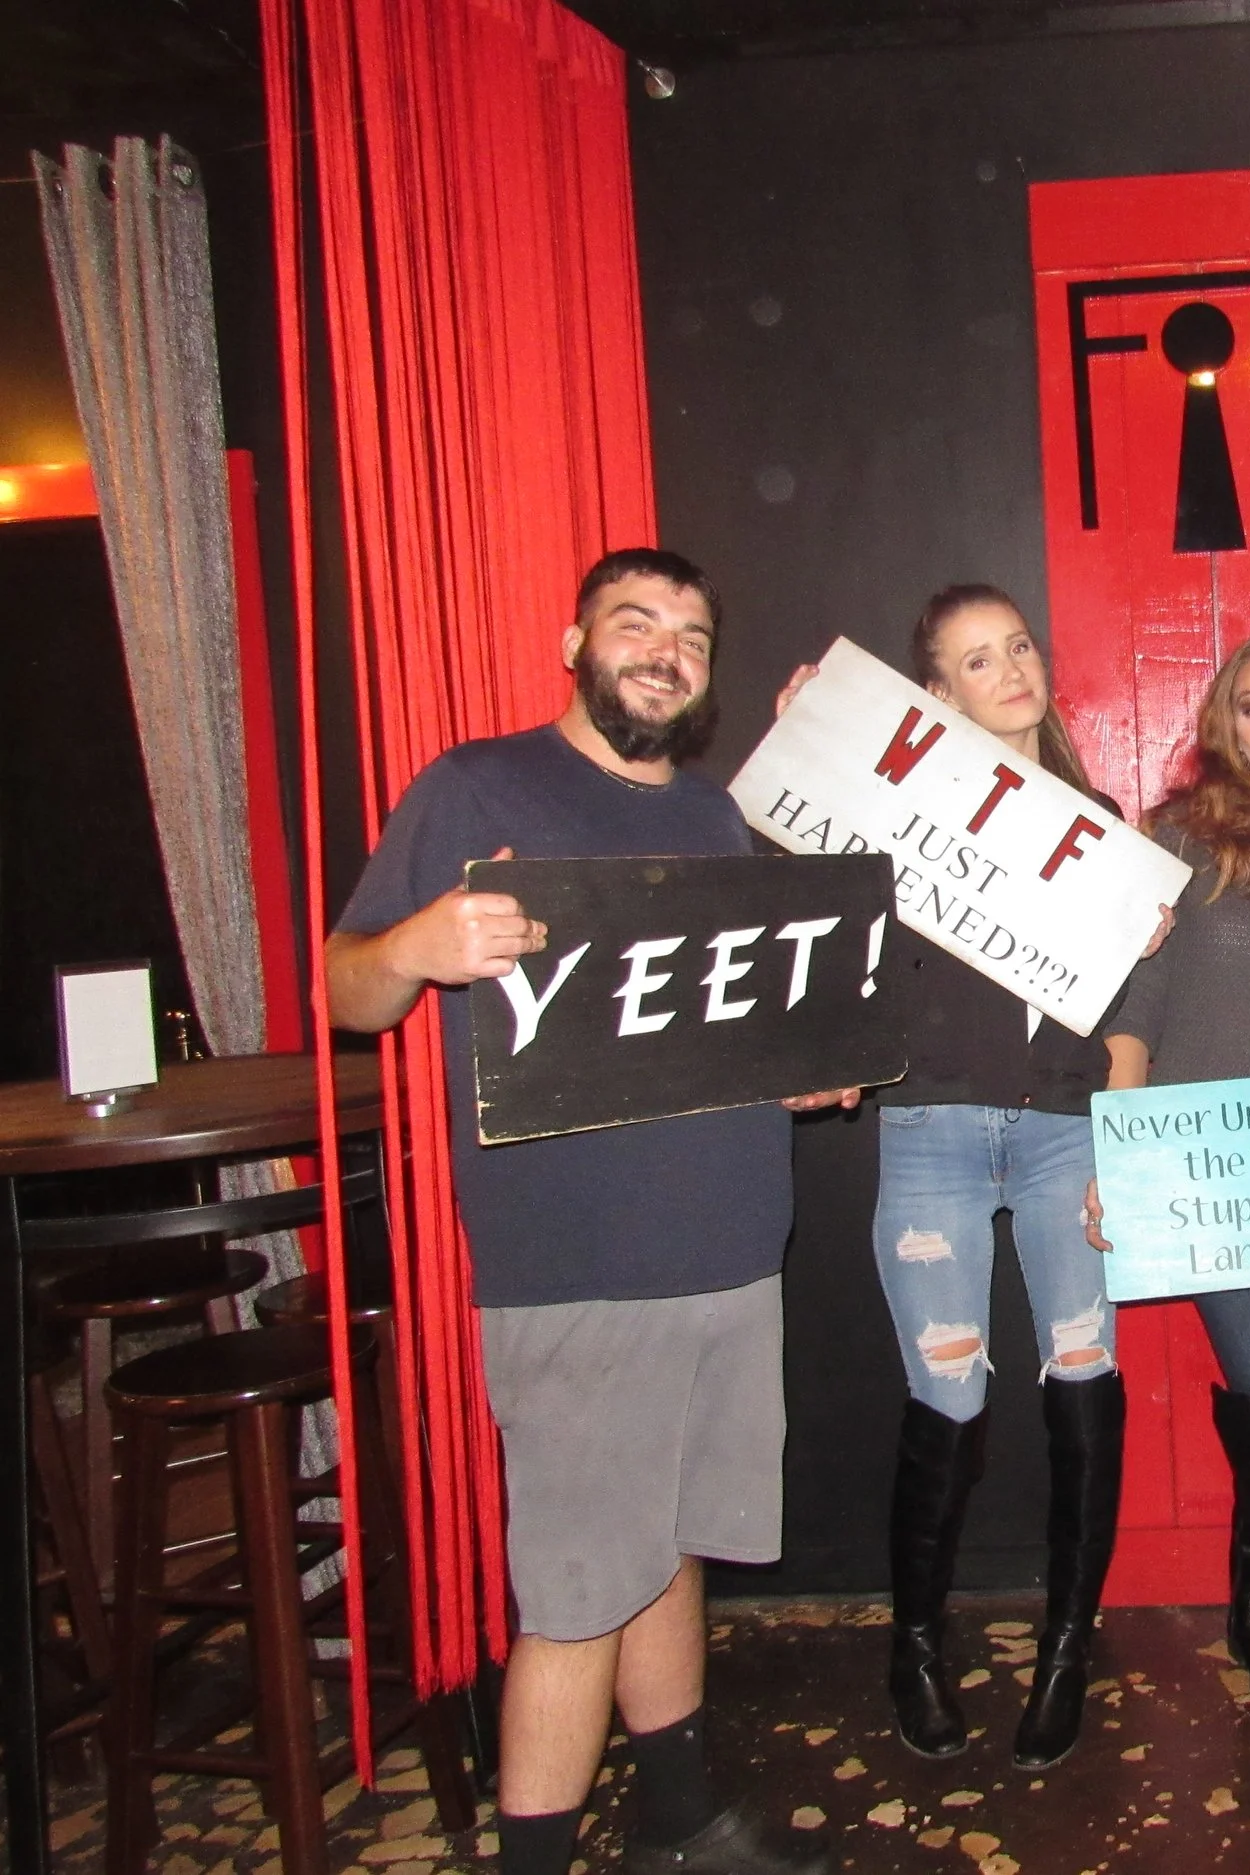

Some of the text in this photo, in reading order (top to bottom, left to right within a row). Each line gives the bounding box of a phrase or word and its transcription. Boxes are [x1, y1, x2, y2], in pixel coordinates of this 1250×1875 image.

[764, 787, 1079, 1003] HAPENED?!?!
[891, 812, 1009, 895] JUST
[497, 911, 888, 1056] YEET!
[1102, 1109, 1211, 1144] Never
[1184, 1148, 1245, 1181] the
